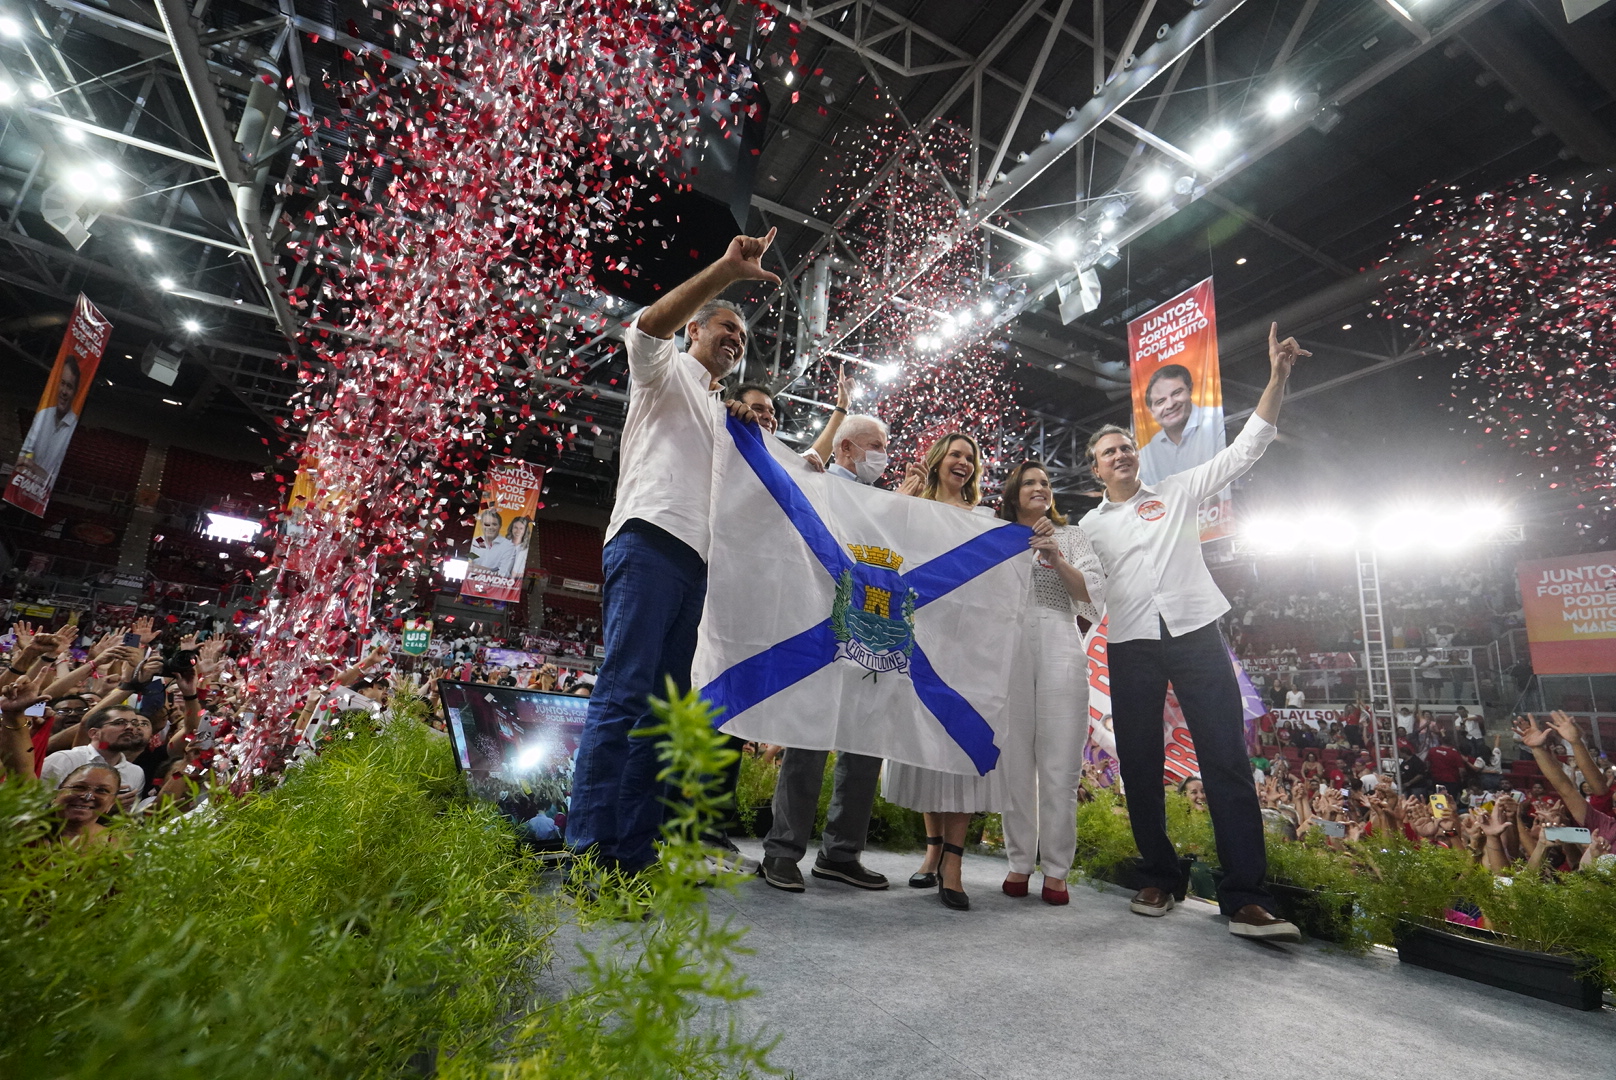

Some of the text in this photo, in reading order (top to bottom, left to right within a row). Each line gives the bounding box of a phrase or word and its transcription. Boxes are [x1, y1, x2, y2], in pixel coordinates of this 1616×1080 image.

[1138, 308, 1204, 349] FORTALEZA
[1140, 297, 1199, 336] JUNTOS,
[1135, 317, 1209, 362] PODE MUITO
[1157, 341, 1186, 363] MAIS
[1563, 593, 1616, 608] PODE
